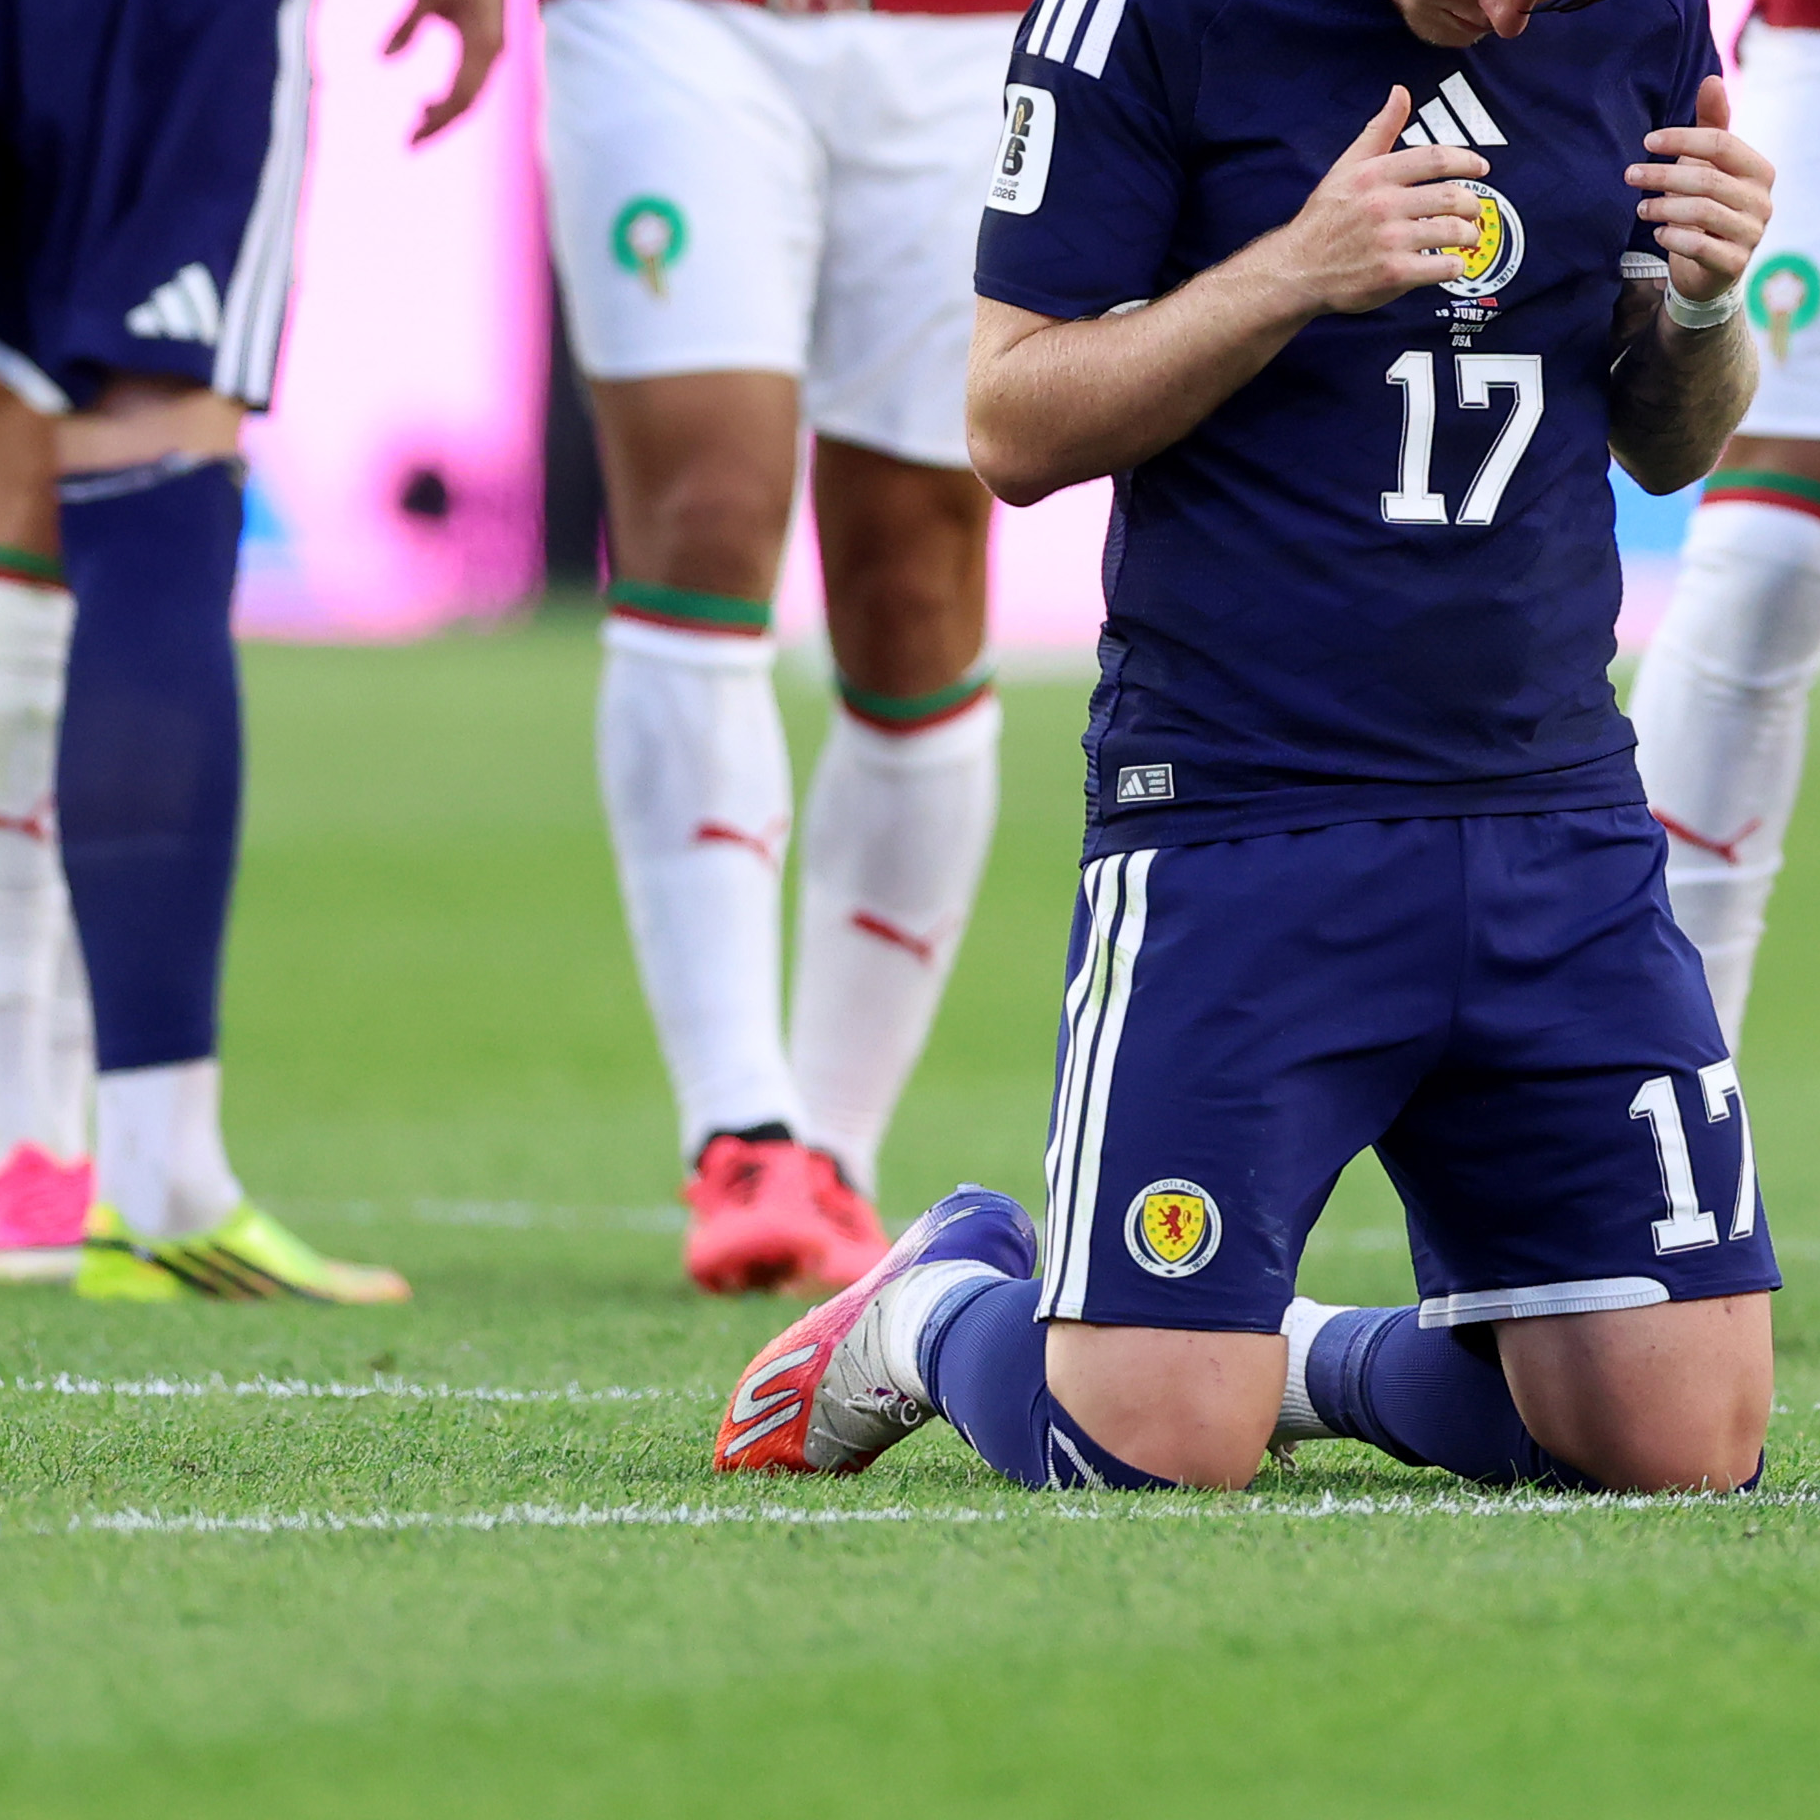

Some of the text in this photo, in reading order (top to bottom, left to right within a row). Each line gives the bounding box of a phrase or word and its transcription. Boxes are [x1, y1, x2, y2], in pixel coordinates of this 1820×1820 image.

[992, 186, 1017, 201] 2026
[1496, 267, 1514, 285] 1873
[1453, 307, 1484, 321] JUNE
[1451, 335, 1472, 348] USA
[1381, 351, 1544, 525] 17
[1628, 1056, 1756, 1255] 17
[1152, 1180, 1199, 1194] SCOTLAND
